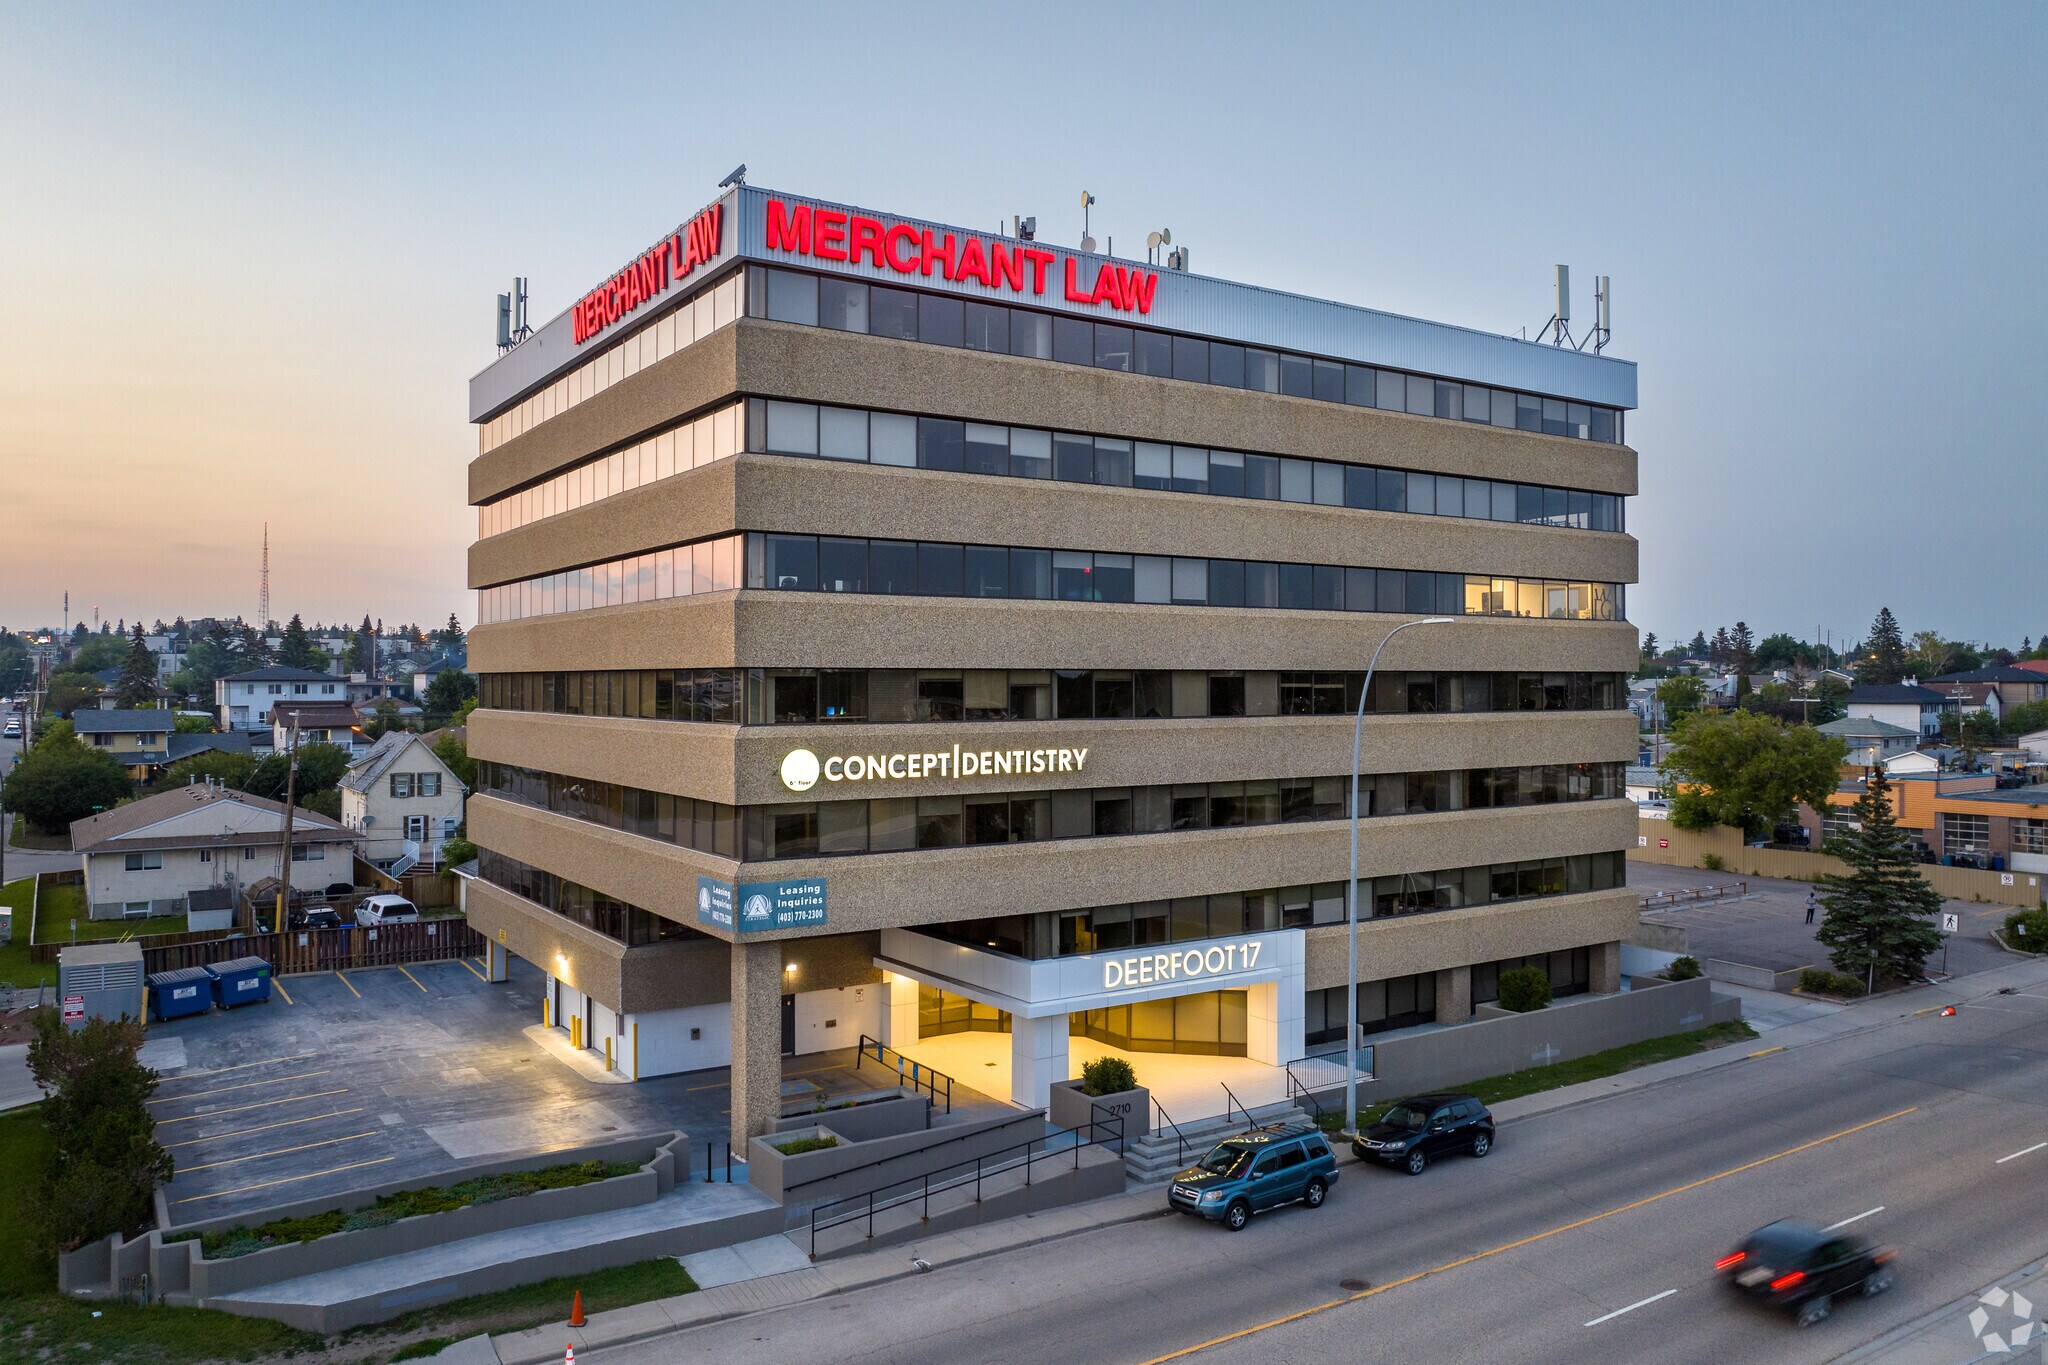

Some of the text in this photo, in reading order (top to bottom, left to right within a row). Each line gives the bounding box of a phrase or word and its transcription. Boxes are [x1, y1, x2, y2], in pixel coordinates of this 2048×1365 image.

[767, 199, 1158, 314] MERCHANT LAW
[571, 203, 722, 345] MERCHANT LAW
[824, 748, 1088, 782] CONCEPT DENTISTRY
[712, 885, 731, 900] Leasing
[779, 884, 820, 896] Leasing
[777, 896, 823, 908] Inquiries
[777, 909, 823, 923] (403) 770-2300
[1104, 942, 1262, 989] DEERFOOT 17
[1109, 1102, 1131, 1117] 2710
